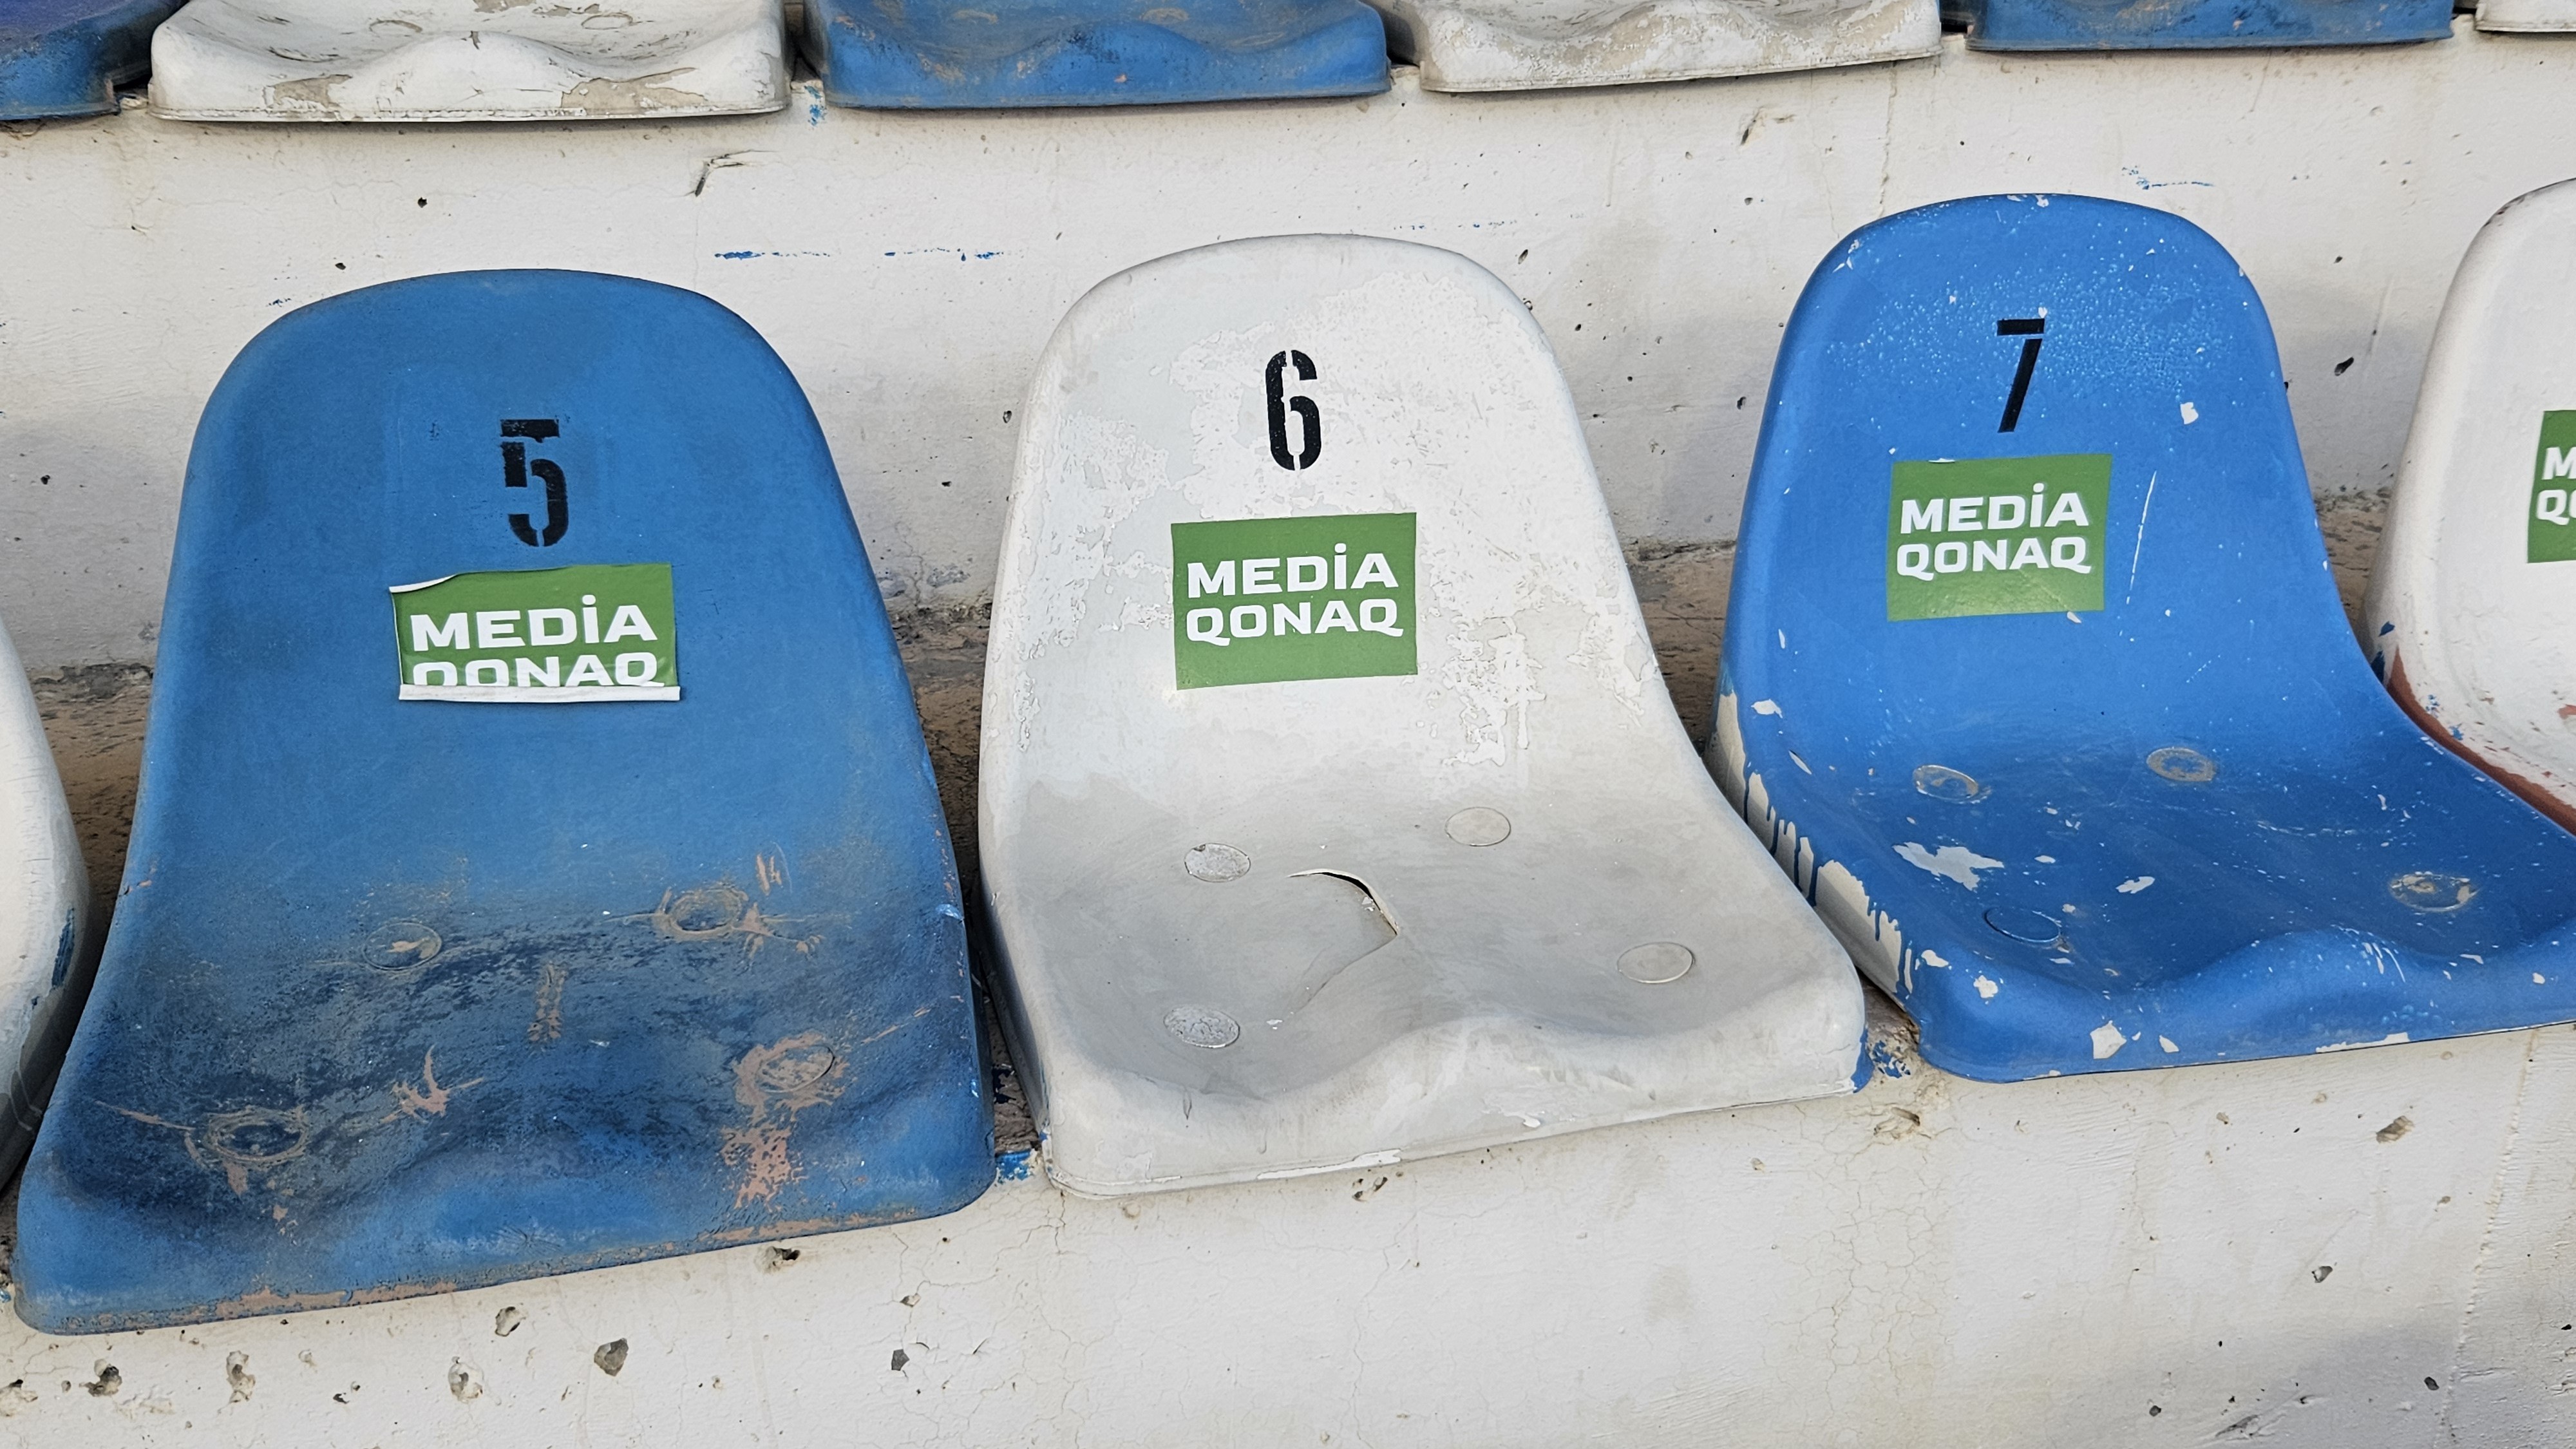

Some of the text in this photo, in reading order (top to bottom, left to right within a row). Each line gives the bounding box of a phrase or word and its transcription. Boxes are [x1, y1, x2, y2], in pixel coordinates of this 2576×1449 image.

[1265, 350, 1321, 471] 6
[1997, 319, 2045, 433] 7
[500, 419, 569, 547] 5
[1897, 536, 2092, 582] QONAQ
[1186, 598, 1403, 647] QONAQ
